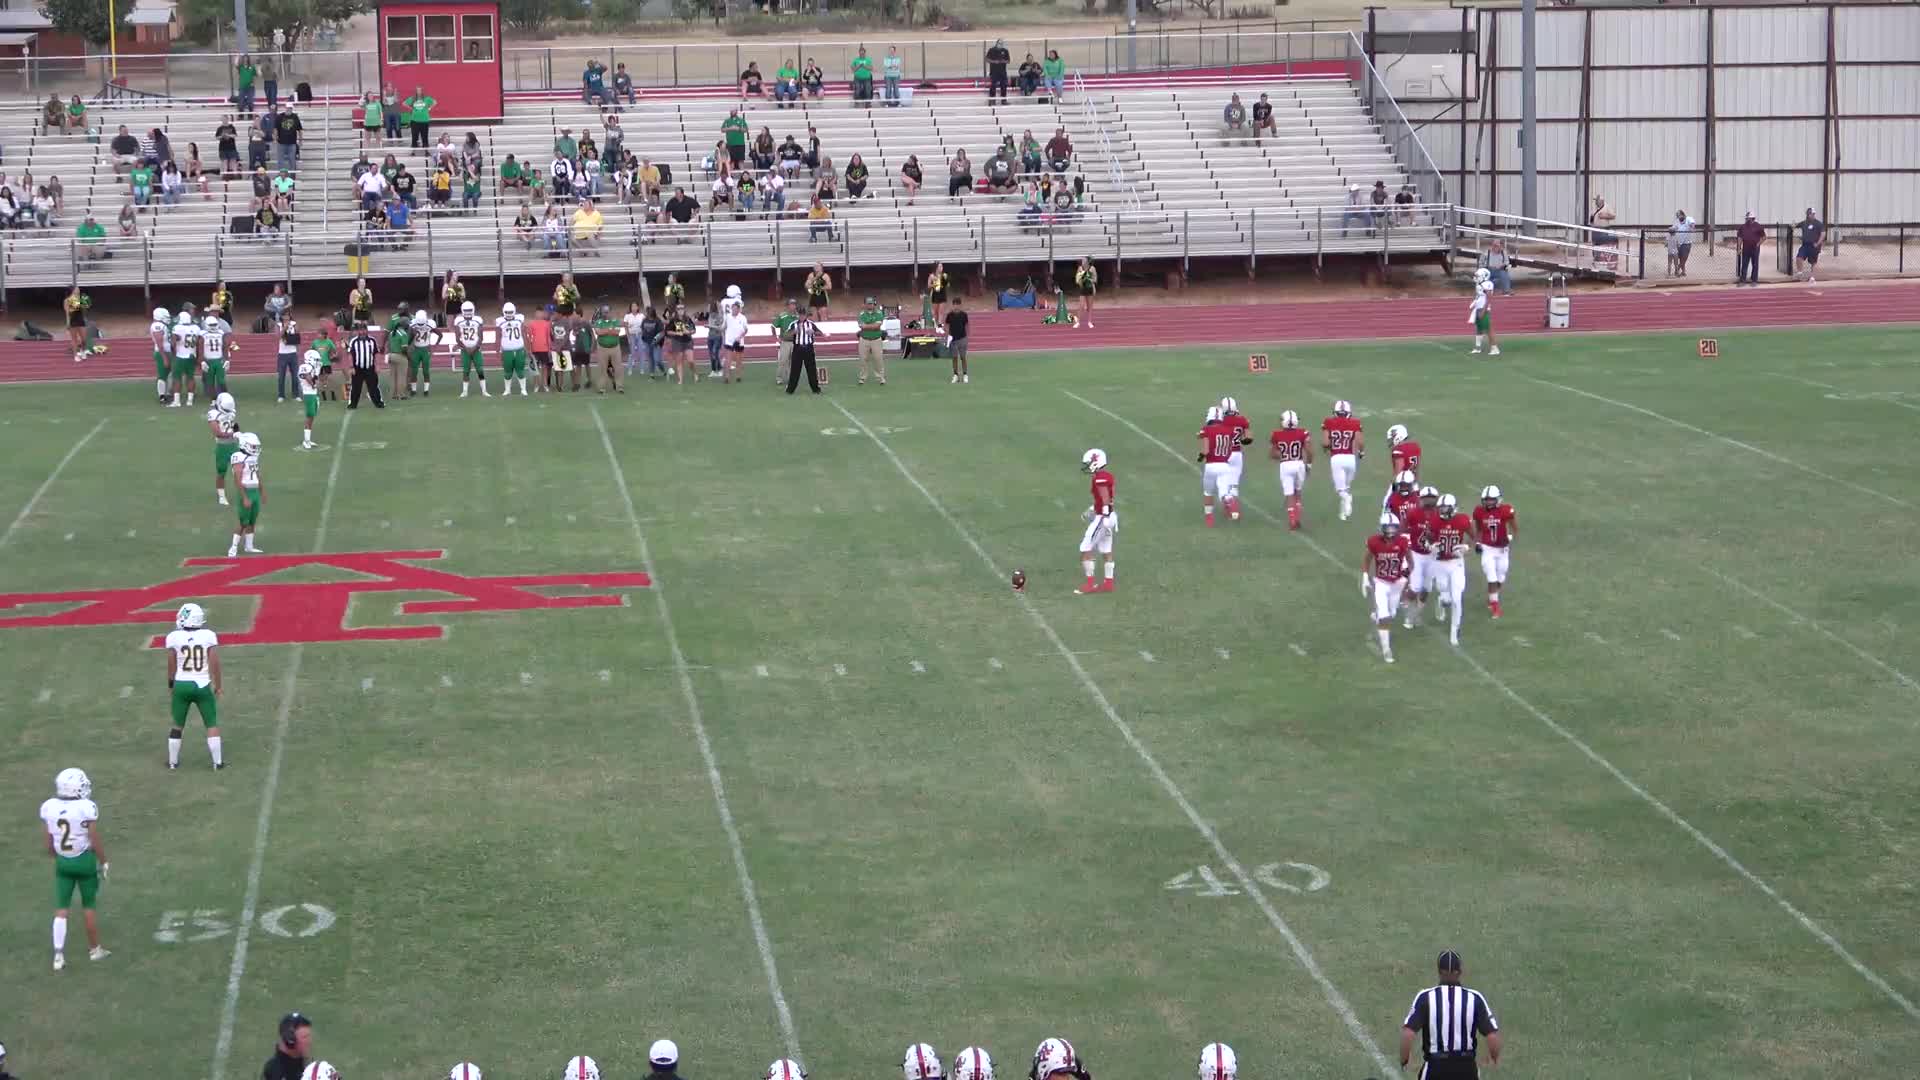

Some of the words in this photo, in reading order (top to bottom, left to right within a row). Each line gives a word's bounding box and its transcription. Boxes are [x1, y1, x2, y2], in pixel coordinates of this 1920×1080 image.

[415, 331, 428, 343] 24
[463, 328, 476, 341] 52
[507, 327, 521, 341] 70
[208, 338, 219, 352] 11
[1701, 340, 1717, 354] 20
[1251, 355, 1267, 370] 30
[1214, 433, 1231, 457] 11
[1331, 430, 1354, 450] 27
[1278, 440, 1302, 461] 20
[180, 643, 205, 673] 20
[56, 818, 74, 852] 2
[1163, 861, 1332, 898] 40
[152, 903, 338, 943] 50
